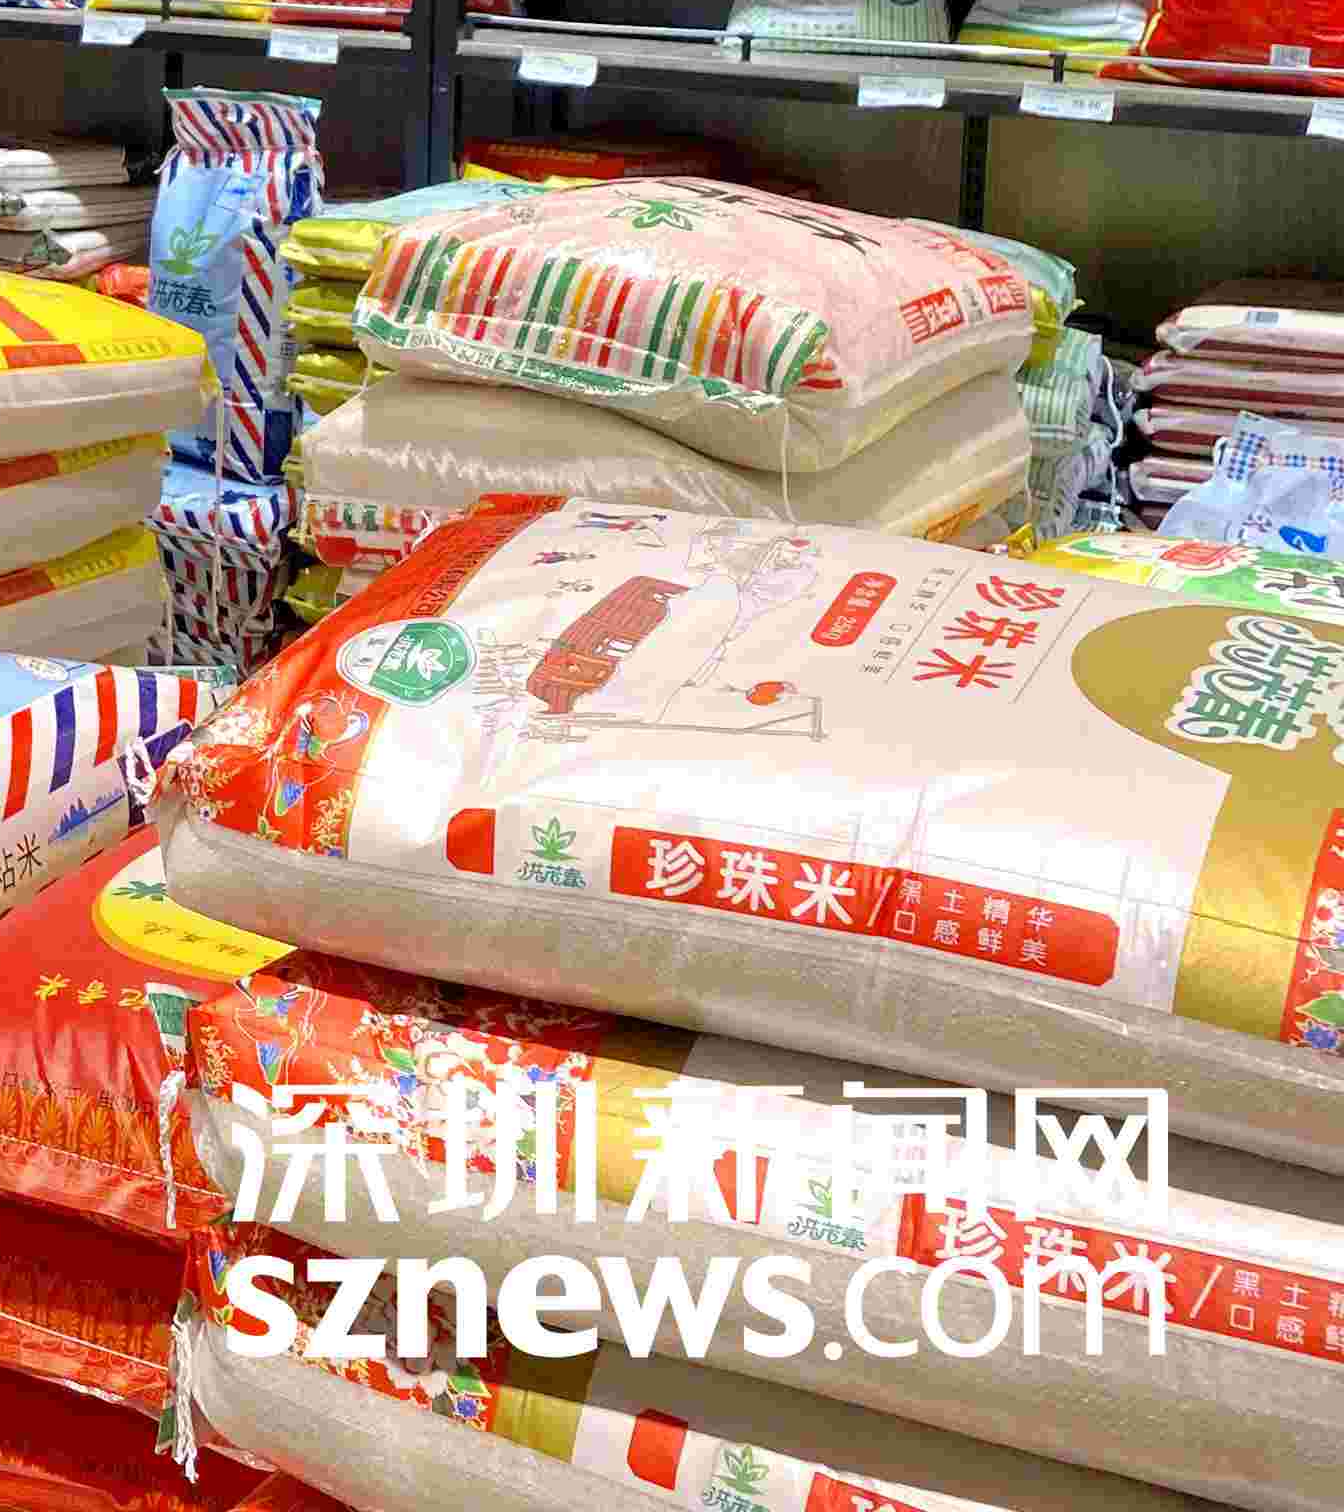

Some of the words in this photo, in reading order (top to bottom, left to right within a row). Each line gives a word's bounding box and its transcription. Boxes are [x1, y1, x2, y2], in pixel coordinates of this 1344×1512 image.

[912, 574, 1066, 689] 珍珠米
[644, 838, 857, 926] 珍珠米
[899, 877, 1057, 933] 黑土精华
[892, 909, 1049, 967] 口感鲜美
